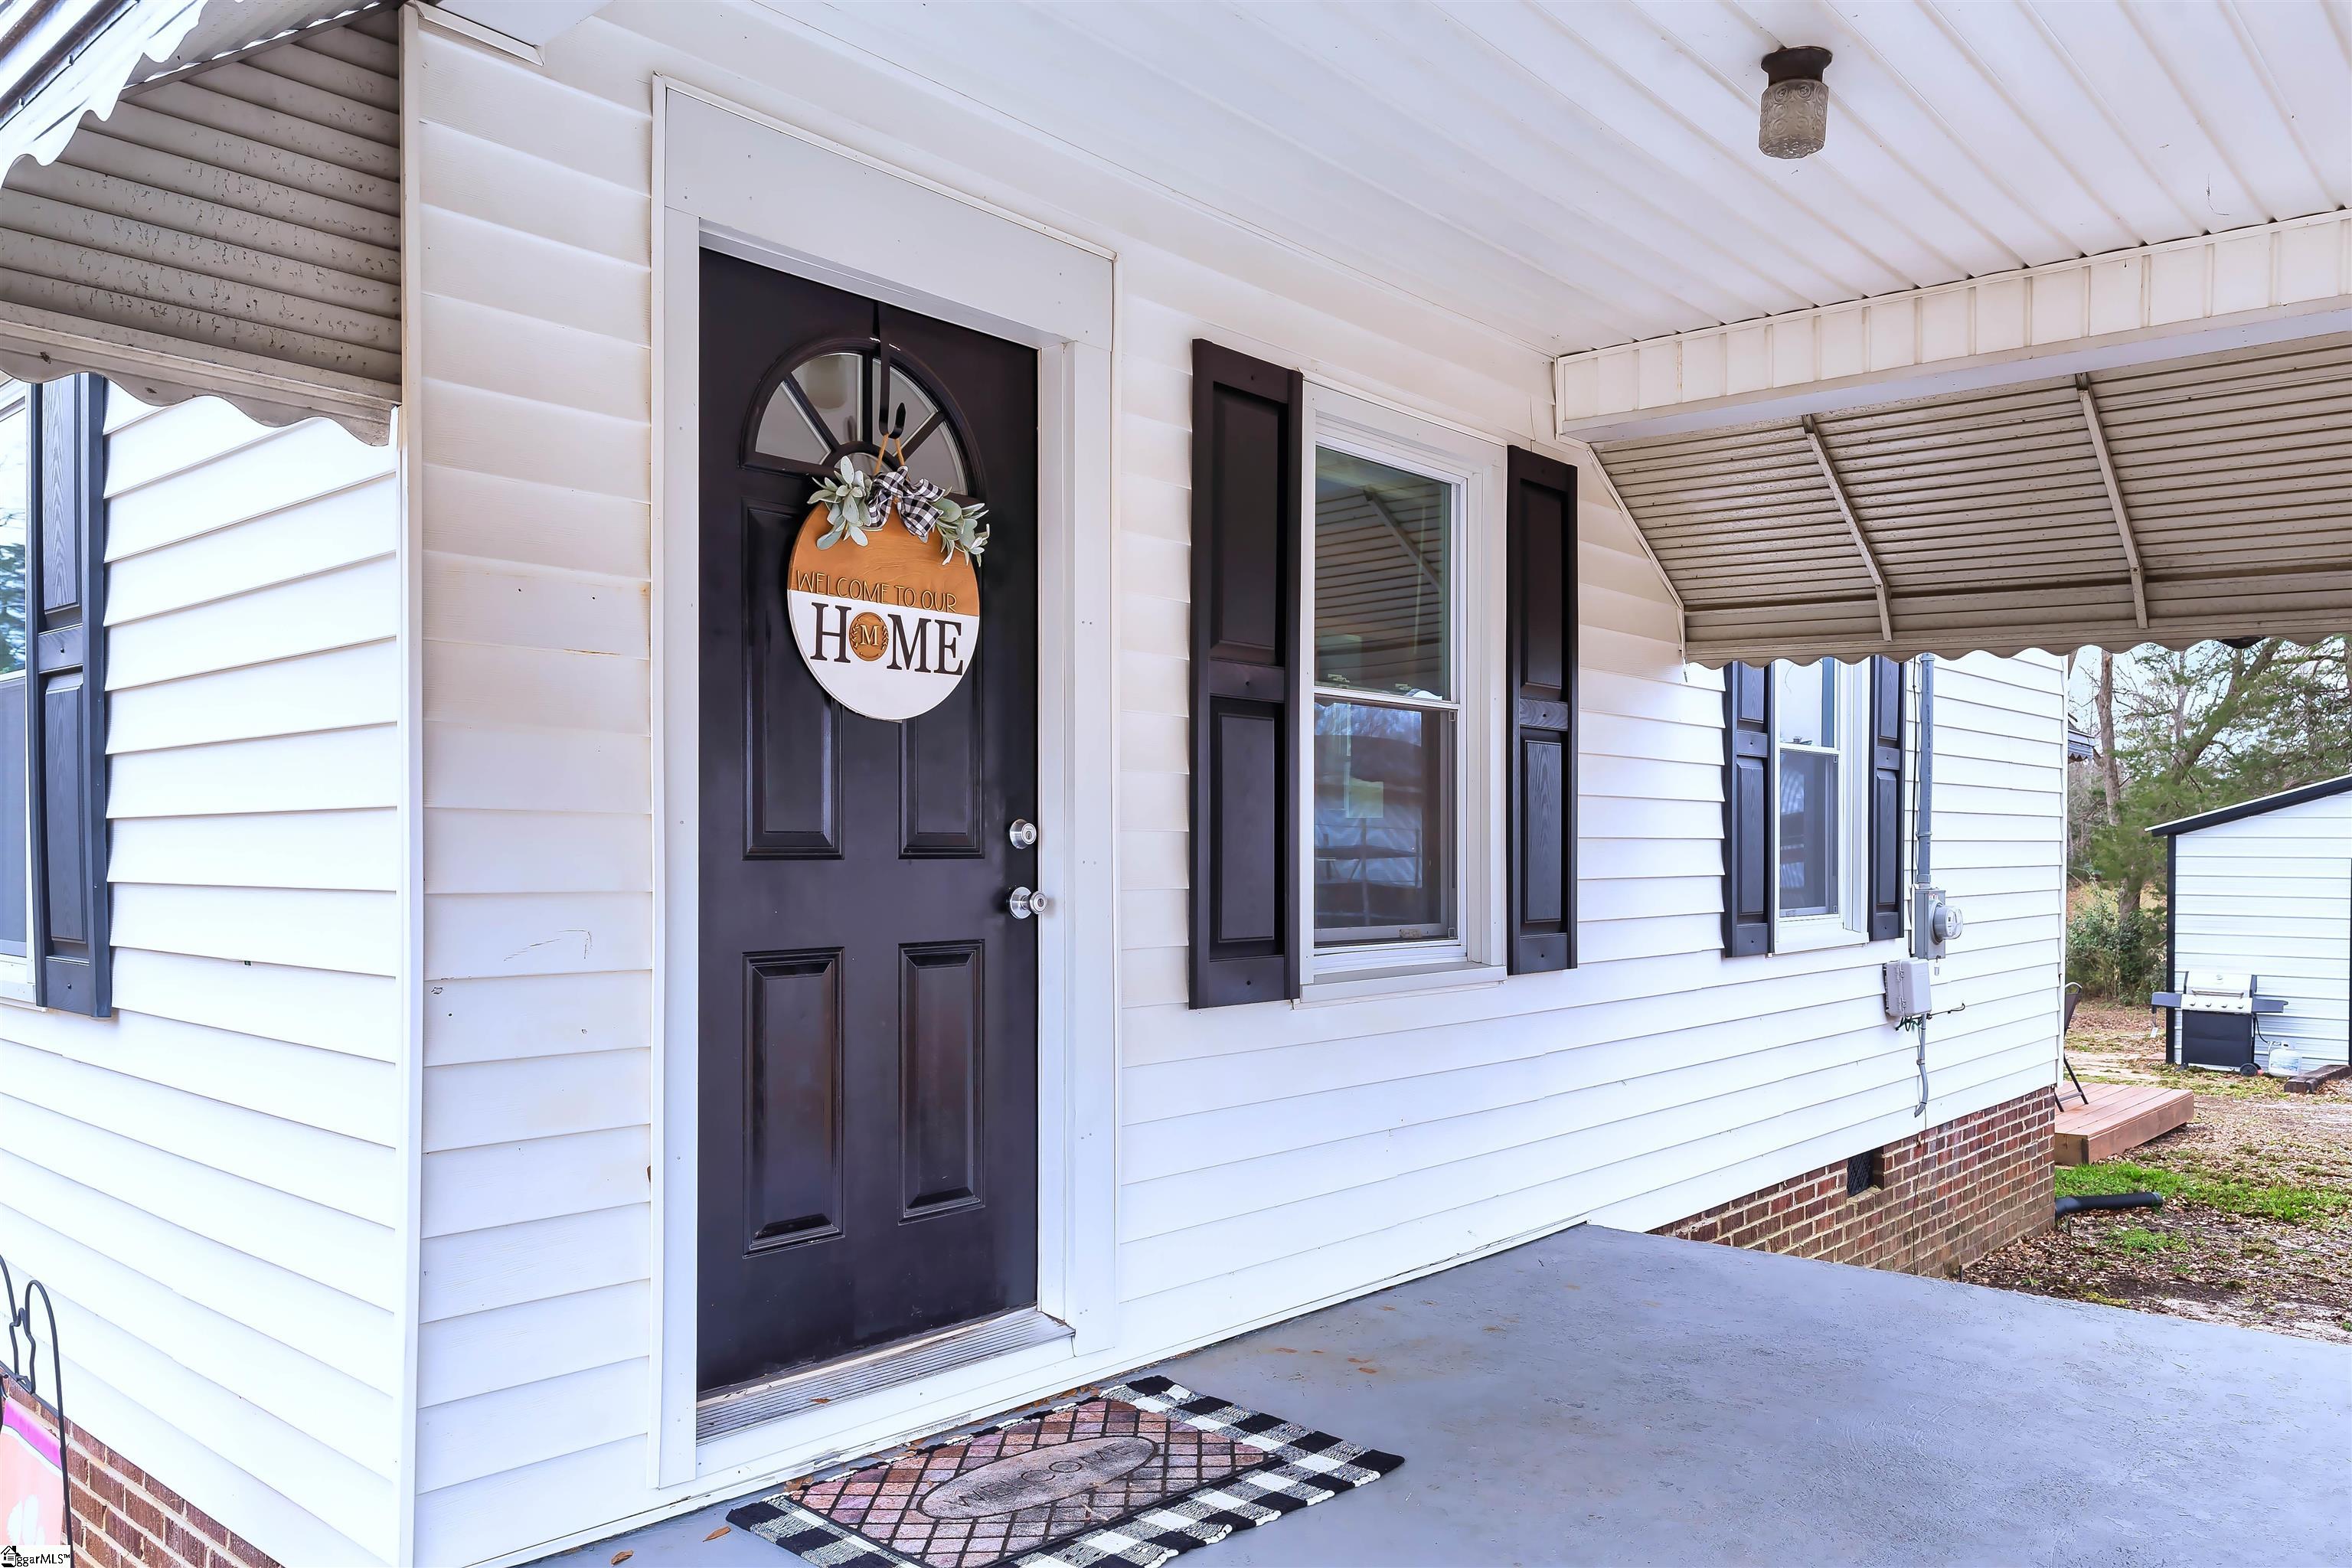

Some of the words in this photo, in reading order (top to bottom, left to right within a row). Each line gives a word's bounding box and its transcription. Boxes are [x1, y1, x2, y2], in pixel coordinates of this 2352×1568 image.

[796, 570, 890, 604] WELCOME
[895, 584, 916, 608] TO
[921, 590, 958, 613] OUR
[860, 624, 880, 647] M
[942, 1440, 1137, 1508] WELCOME
